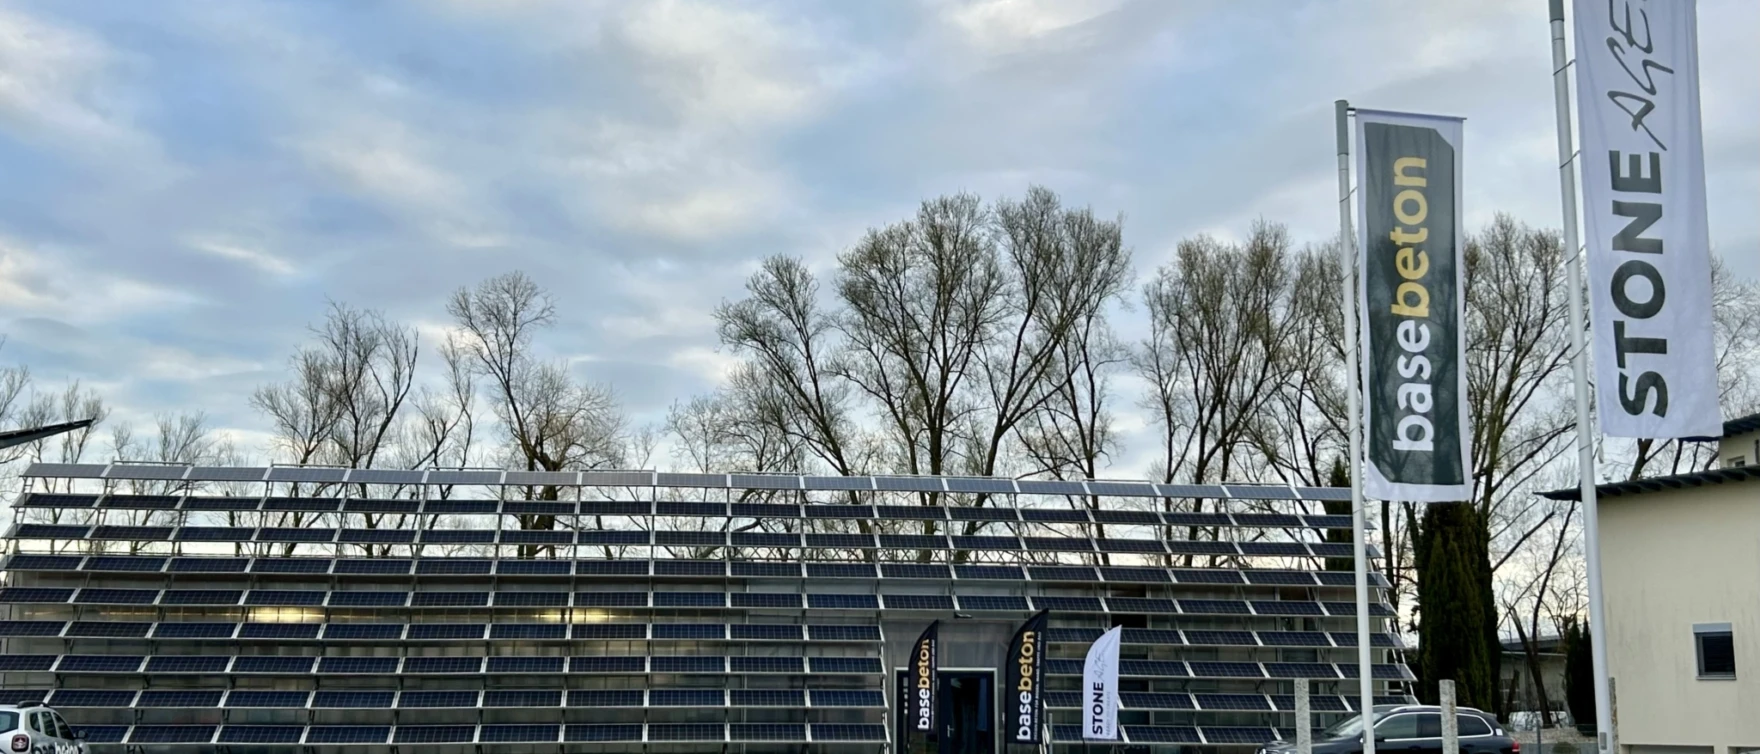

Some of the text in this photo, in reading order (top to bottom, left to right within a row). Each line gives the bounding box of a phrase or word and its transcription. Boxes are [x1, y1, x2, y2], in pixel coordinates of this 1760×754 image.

[1390, 156, 1435, 453] basebeton
[1608, 149, 1669, 419] STONE
[917, 638, 930, 730] basebeton
[1016, 630, 1036, 741] basebeton
[1092, 681, 1105, 735] STONE
